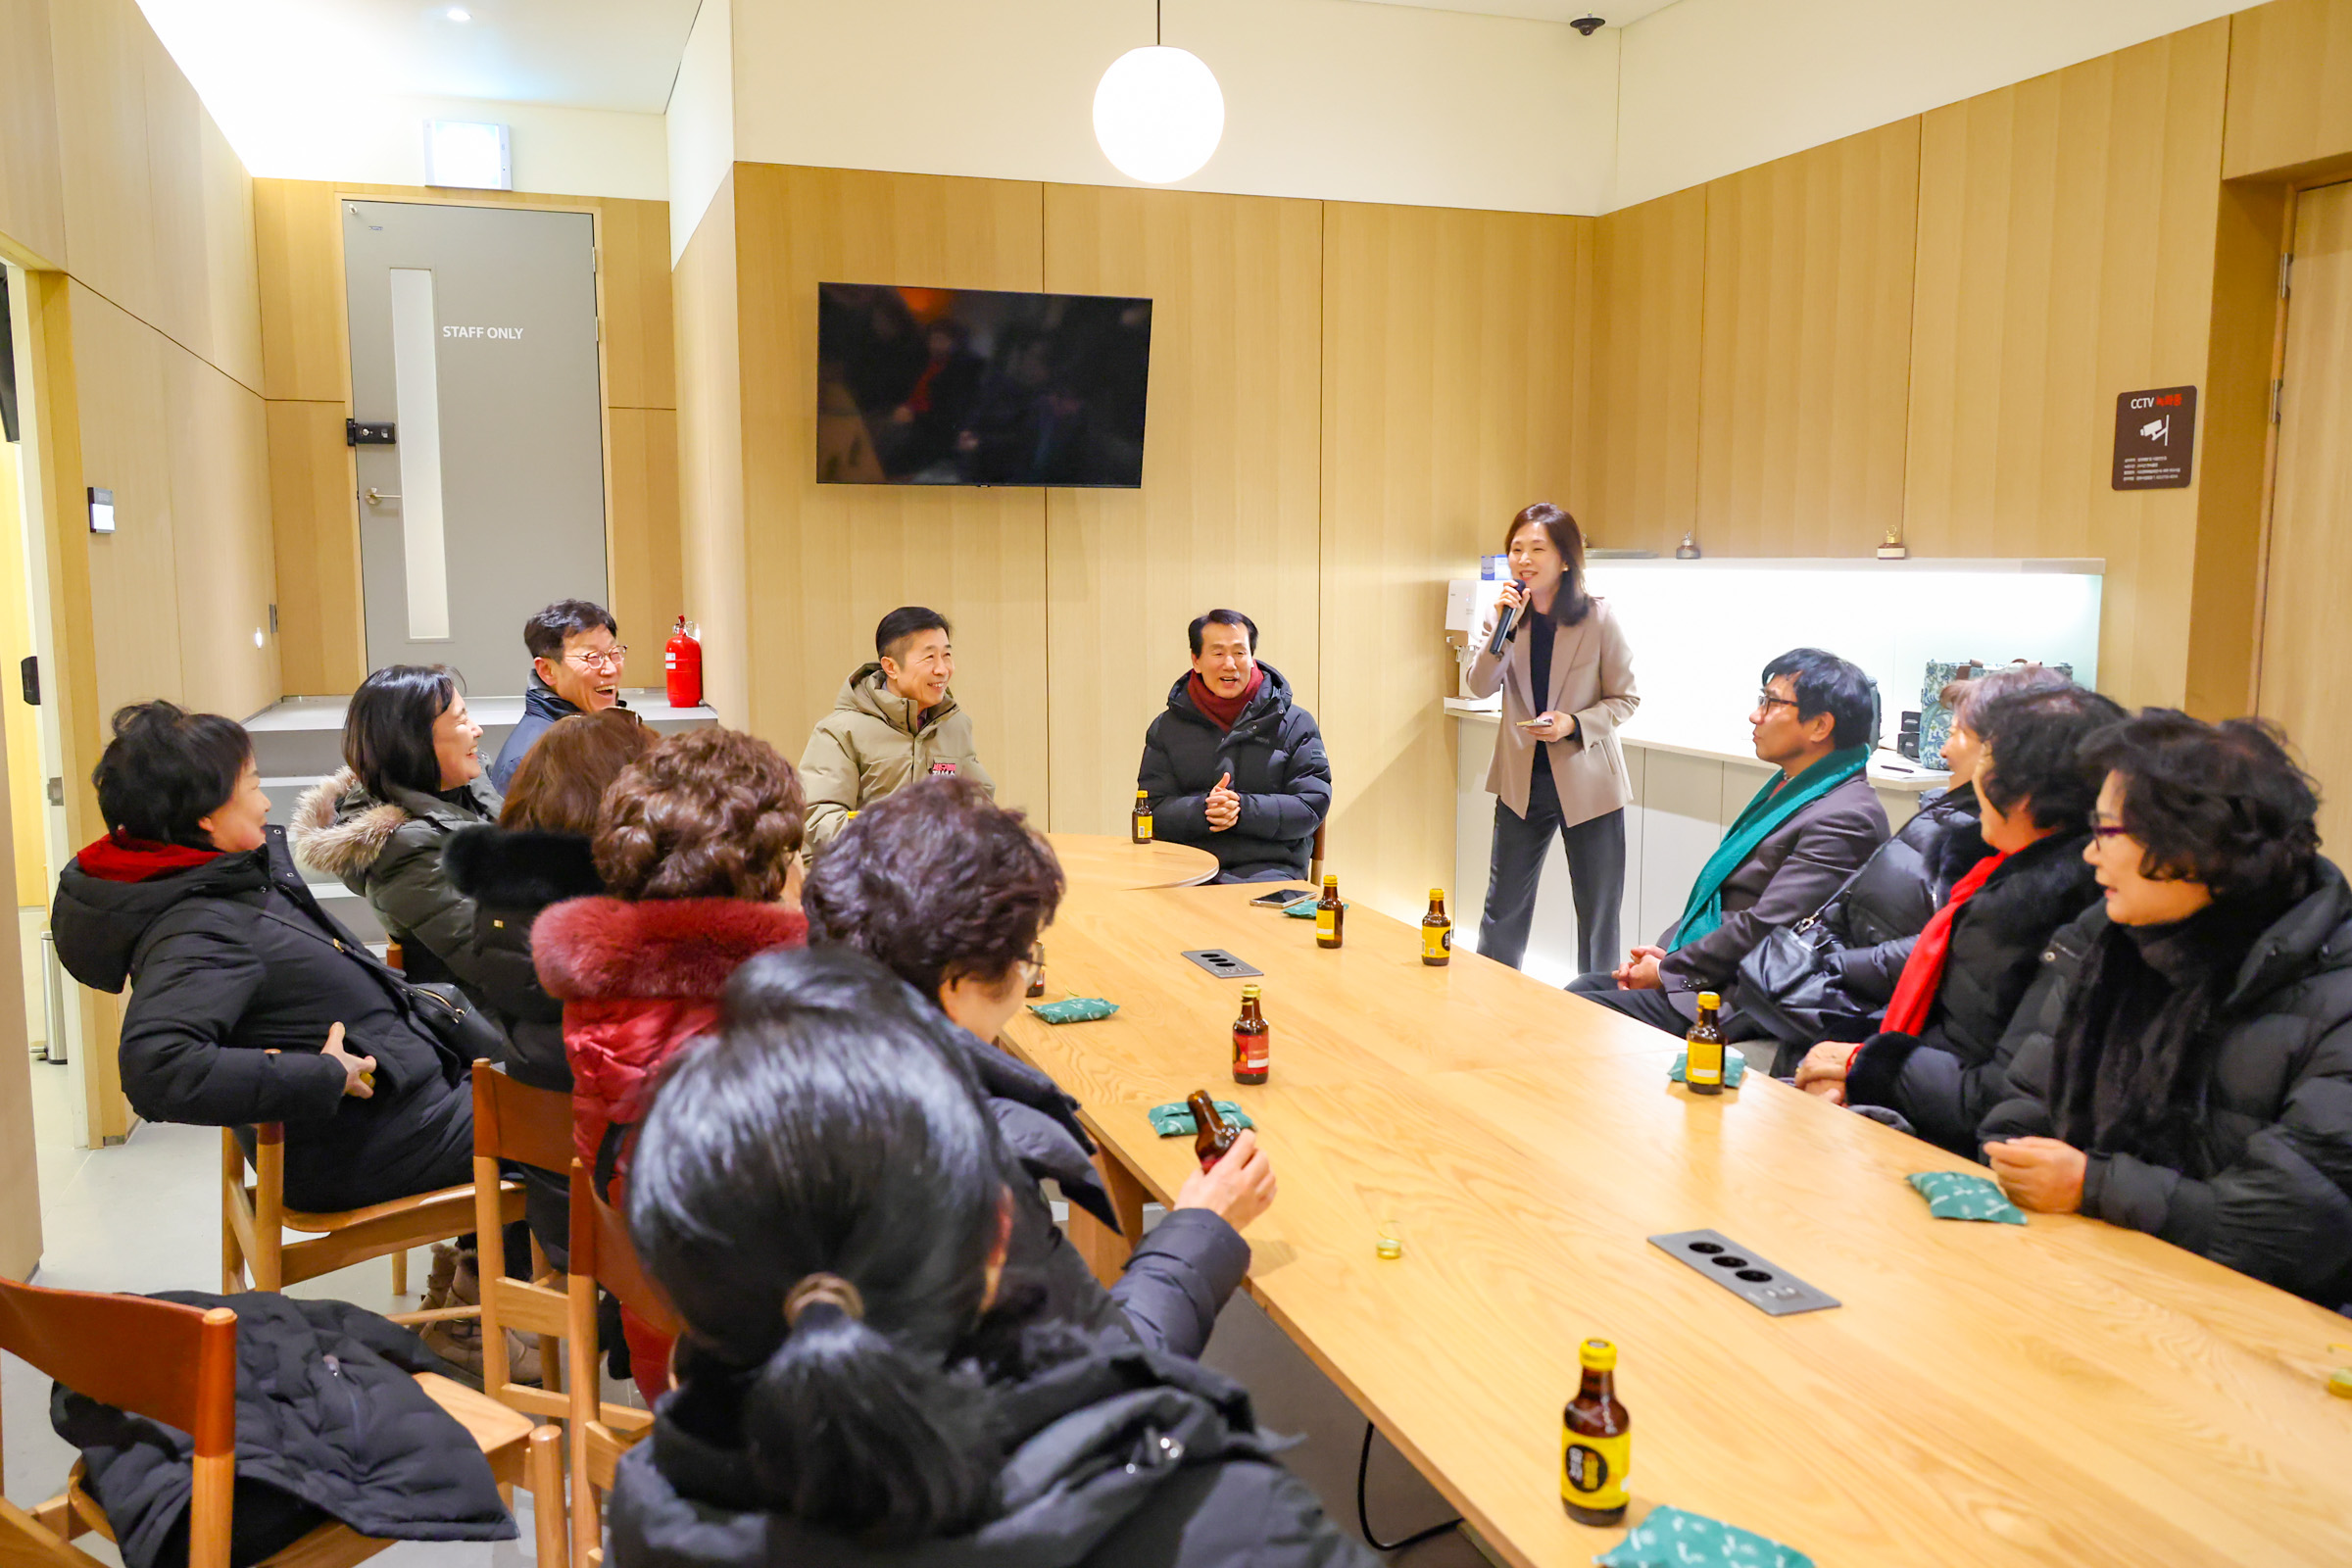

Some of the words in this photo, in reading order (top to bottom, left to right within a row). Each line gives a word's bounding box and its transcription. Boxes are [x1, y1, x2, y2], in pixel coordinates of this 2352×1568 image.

[442, 325, 484, 338] STAFF
[486, 326, 523, 339] ONLY
[2131, 397, 2155, 410] CCTV
